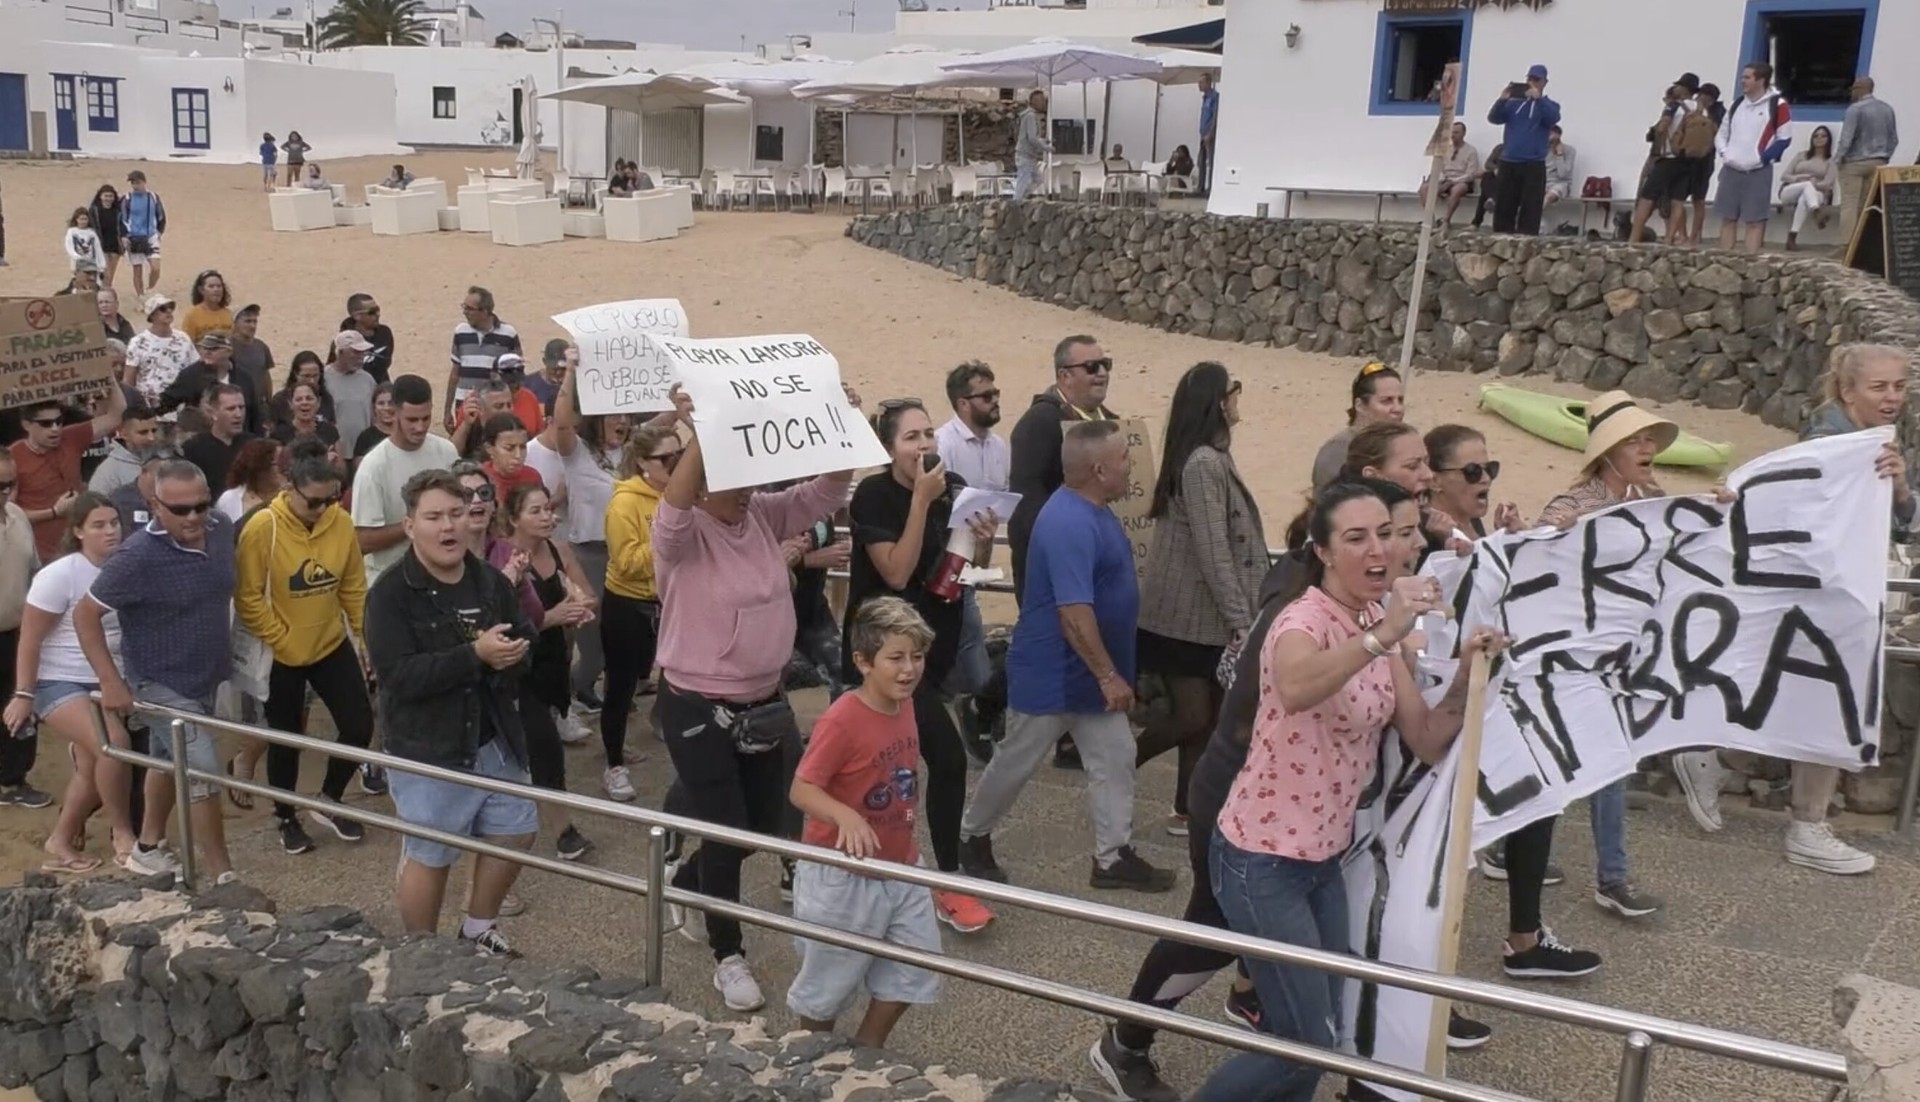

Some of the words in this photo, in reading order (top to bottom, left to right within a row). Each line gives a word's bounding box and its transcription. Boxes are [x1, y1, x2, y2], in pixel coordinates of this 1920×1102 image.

[665, 342, 738, 365] PLAYA
[585, 367, 650, 393] PUEBLO
[652, 365, 671, 385] SE
[729, 378, 768, 399] NO
[773, 374, 812, 394] SE
